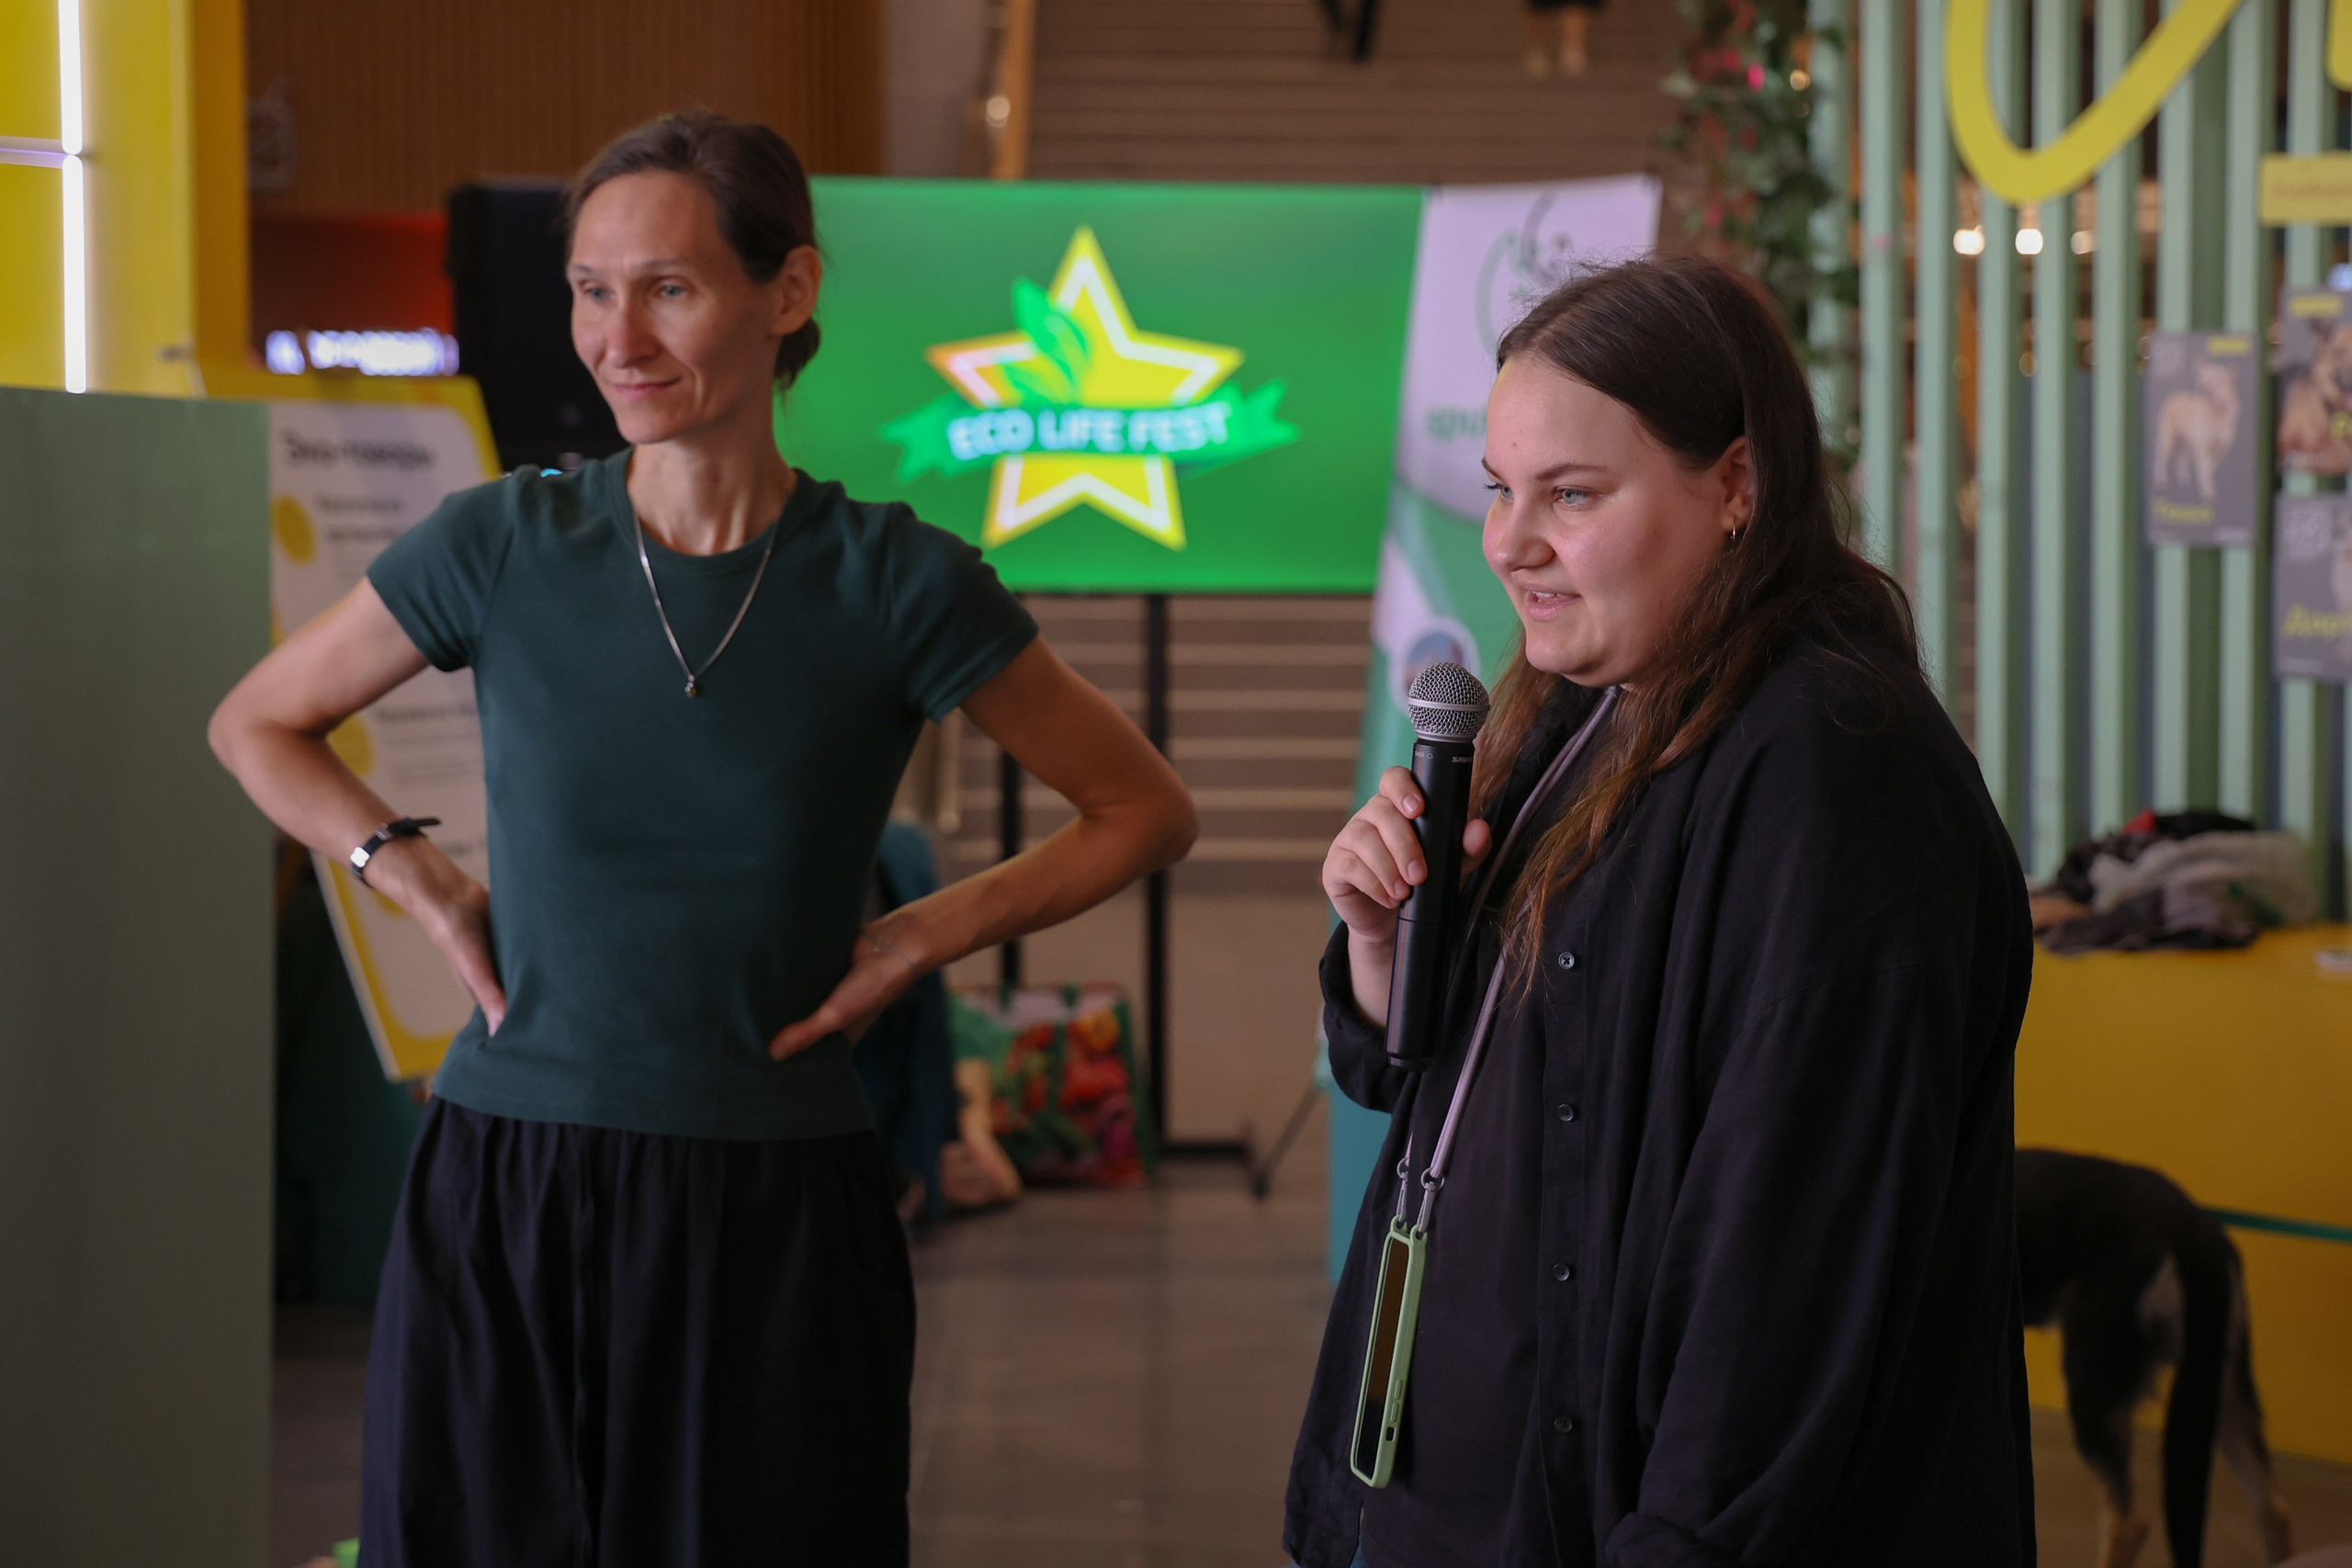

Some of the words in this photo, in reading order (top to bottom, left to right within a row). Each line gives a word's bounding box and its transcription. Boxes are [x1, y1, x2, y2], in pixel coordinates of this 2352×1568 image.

[948, 411, 1035, 460] ECO
[1037, 410, 1125, 452] LIFE
[1127, 401, 1232, 453] FEST
